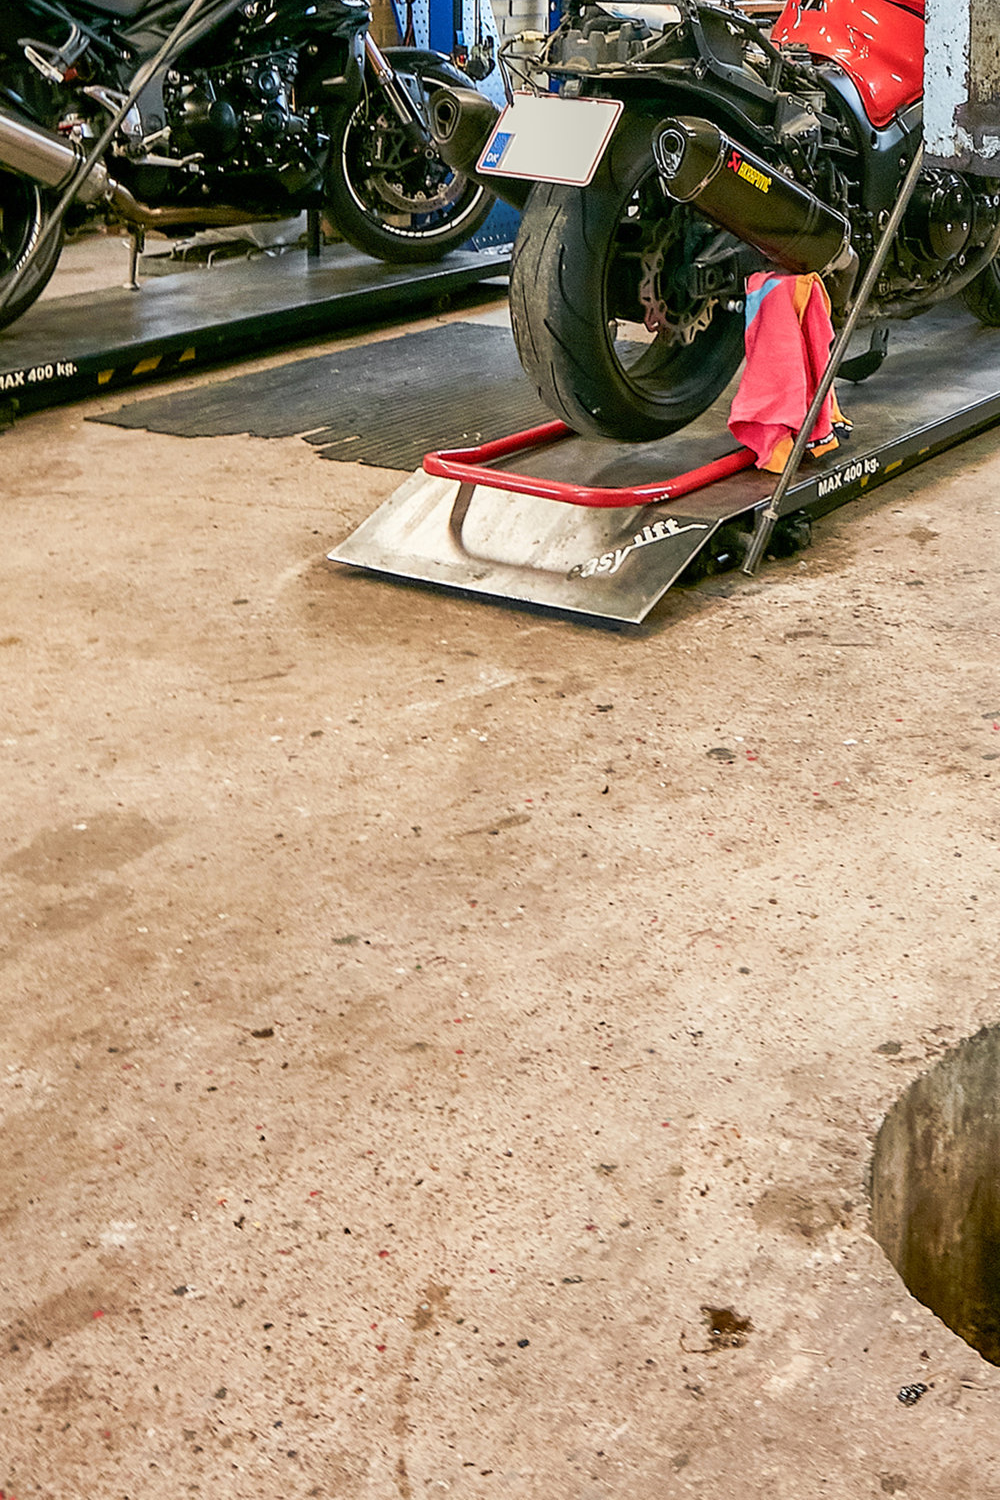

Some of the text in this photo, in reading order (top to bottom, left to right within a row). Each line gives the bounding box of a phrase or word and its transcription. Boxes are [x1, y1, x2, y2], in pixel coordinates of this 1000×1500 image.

[486, 153, 500, 163] DK
[28, 364, 54, 382] 400
[818, 457, 880, 497] MAX 400 kg.
